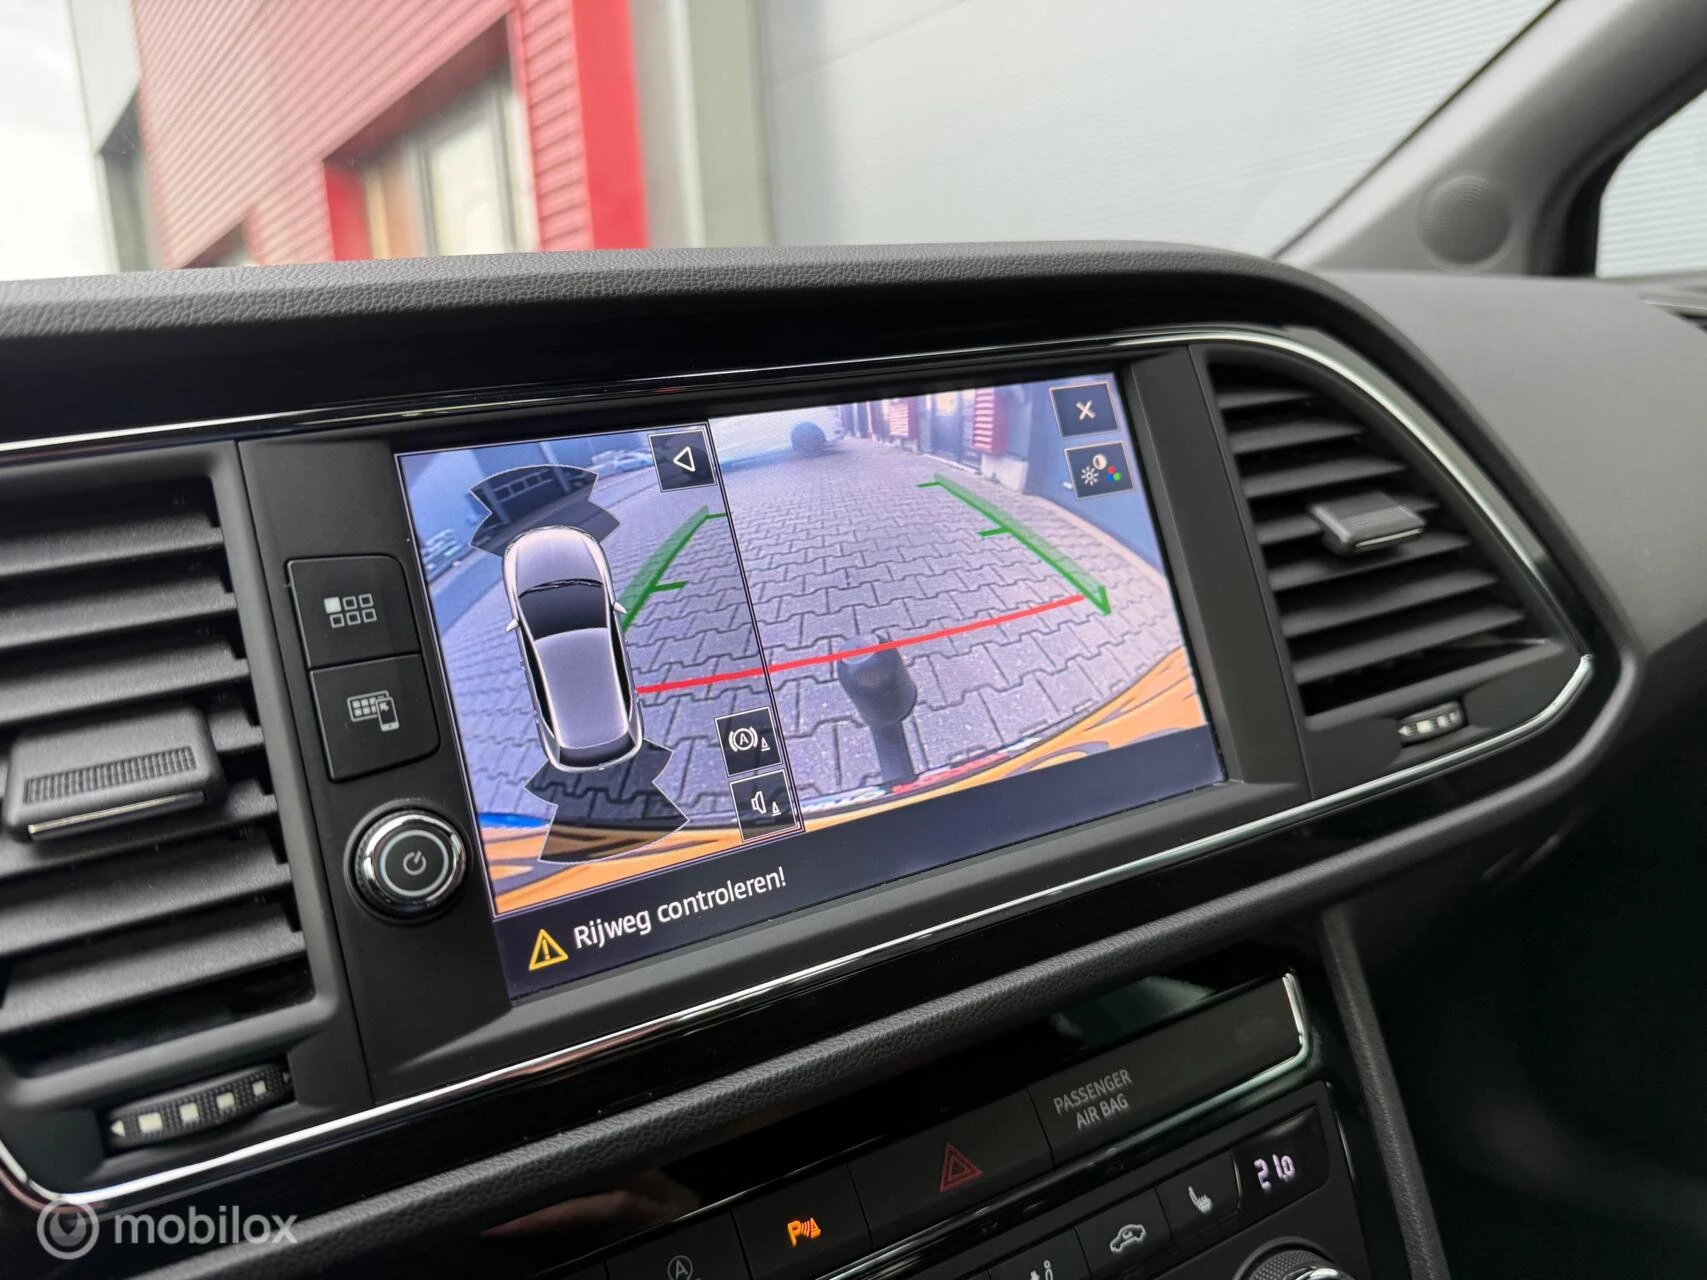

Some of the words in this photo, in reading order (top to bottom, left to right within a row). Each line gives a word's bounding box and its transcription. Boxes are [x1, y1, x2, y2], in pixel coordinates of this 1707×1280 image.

[574, 910, 652, 949] Rijweg
[657, 866, 787, 923] controleren!
[1053, 1069, 1132, 1115] PASSENGER
[1076, 1106, 1100, 1129] AIR
[1100, 1093, 1129, 1117] BAG
